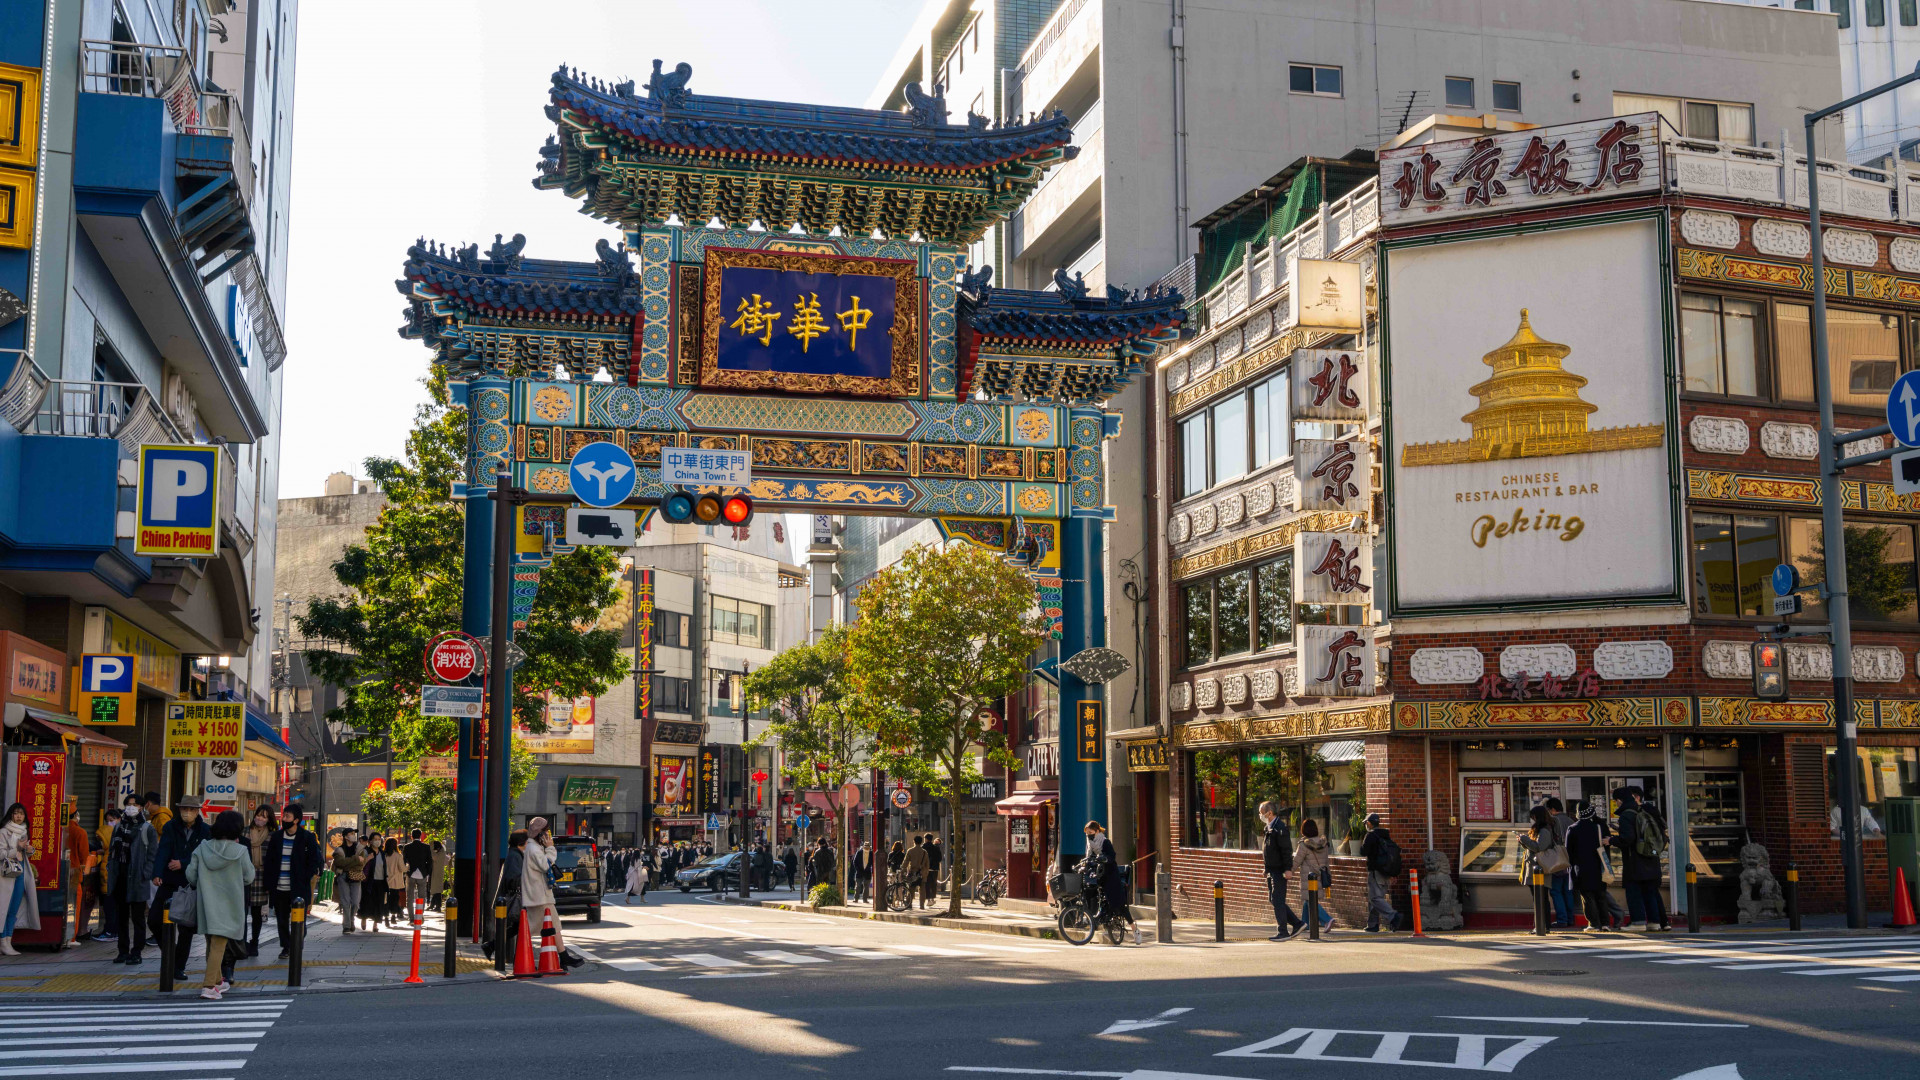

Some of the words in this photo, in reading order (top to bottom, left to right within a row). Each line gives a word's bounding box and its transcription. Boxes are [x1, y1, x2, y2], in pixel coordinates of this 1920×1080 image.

[1392, 119, 1644, 209] 北京飯店
[668, 452, 745, 471] 中華街東門
[674, 469, 700, 480] China
[703, 471, 726, 481] Town
[729, 472, 738, 482] E.
[1501, 472, 1560, 486] CHINESE
[150, 458, 208, 521] P
[1455, 486, 1549, 503] RESTAURANT
[1555, 485, 1564, 497] &
[1569, 482, 1600, 496] BAR
[1308, 352, 1371, 689] 北京飯店
[1470, 506, 1585, 549] Peking
[141, 529, 171, 548] China
[172, 530, 212, 551] Parking
[637, 583, 655, 711] 王府井レストラン
[436, 651, 472, 668] 消火栓
[90, 656, 125, 691] P
[1478, 668, 1600, 702] 北京飯店
[92, 696, 120, 722] 空
[169, 705, 184, 719] P
[186, 705, 241, 719] 時間貸駐車場
[171, 728, 193, 736] 最大料金
[198, 721, 239, 737] ¥1500
[1083, 705, 1097, 754] 朝陽門
[197, 740, 238, 756] ¥2800
[1130, 745, 1165, 766] 北京飯店
[1027, 746, 1048, 777] CAFFE
[206, 784, 235, 794] GiGO
[568, 786, 611, 799] シウマイBAR
